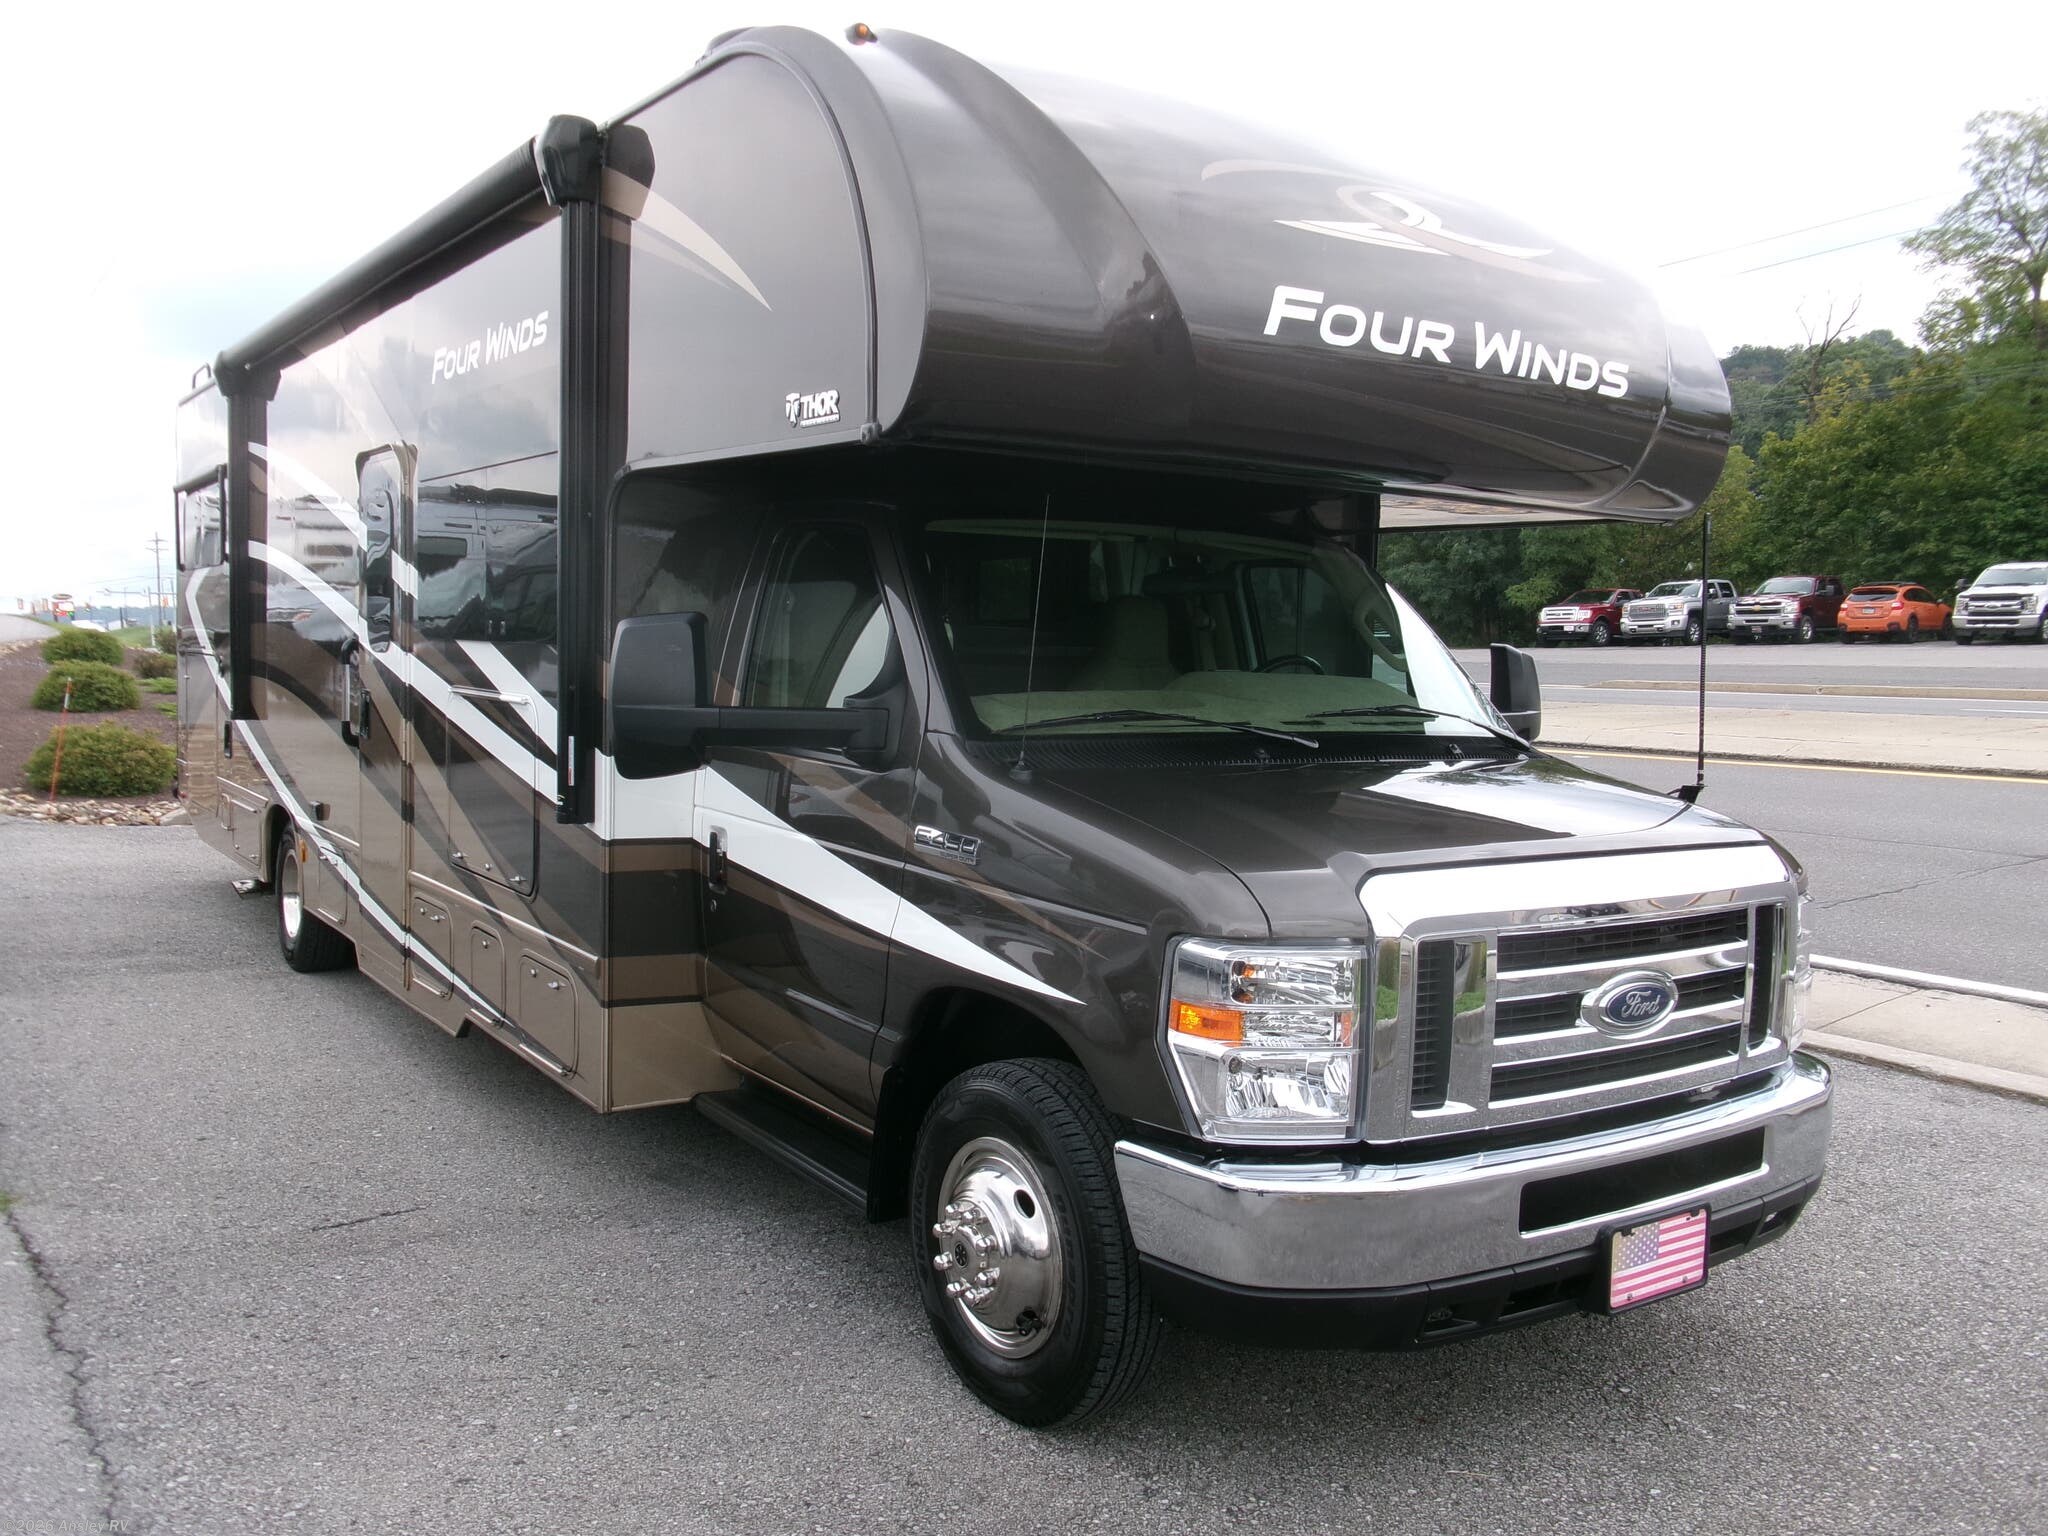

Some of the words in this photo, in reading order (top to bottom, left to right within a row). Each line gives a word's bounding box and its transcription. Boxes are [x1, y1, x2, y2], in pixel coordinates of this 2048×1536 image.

[431, 339, 481, 385] FOUR
[485, 309, 549, 365] WINDS
[1263, 284, 1455, 364] FOUR
[1474, 320, 1630, 399] WINDS
[799, 389, 840, 420] THOR
[1621, 990, 1662, 1018] Ford
